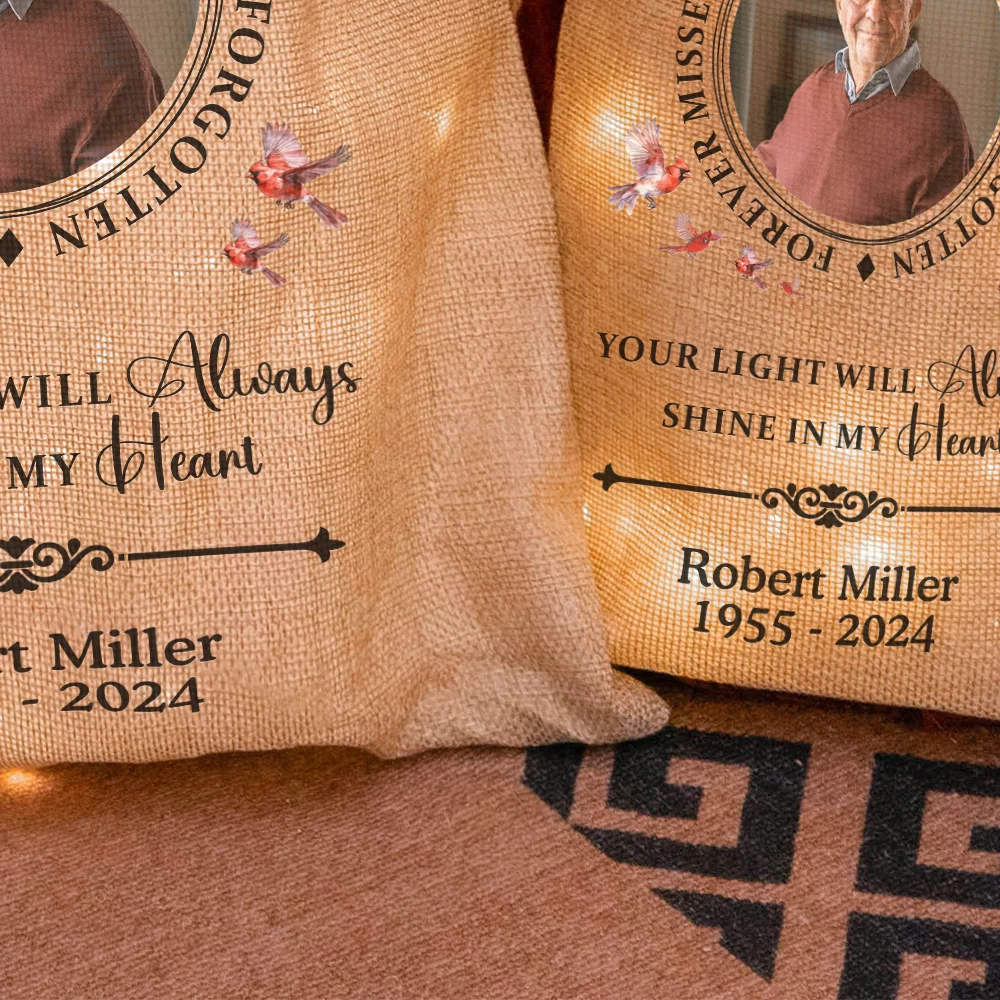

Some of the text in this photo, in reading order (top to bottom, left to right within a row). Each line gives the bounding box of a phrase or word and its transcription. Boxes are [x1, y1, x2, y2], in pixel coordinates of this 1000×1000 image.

[693, 131, 837, 274] FOREVER
[892, 172, 1000, 281] OTTEN
[126, 330, 362, 426] Always
[597, 332, 700, 371] YOUR
[711, 347, 826, 386] LIGHT
[834, 362, 916, 394] WILL
[6, 452, 81, 491] MY
[96, 411, 263, 495] Heart
[661, 402, 777, 441] SHINE
[788, 418, 827, 447] IN
[836, 423, 888, 452] MY
[677, 546, 960, 603] Robert Miller
[48, 626, 223, 672] Miller
[692, 600, 797, 648] 1955
[835, 613, 936, 654] 2024
[21, 698, 40, 706] -
[59, 676, 206, 714] 2024
